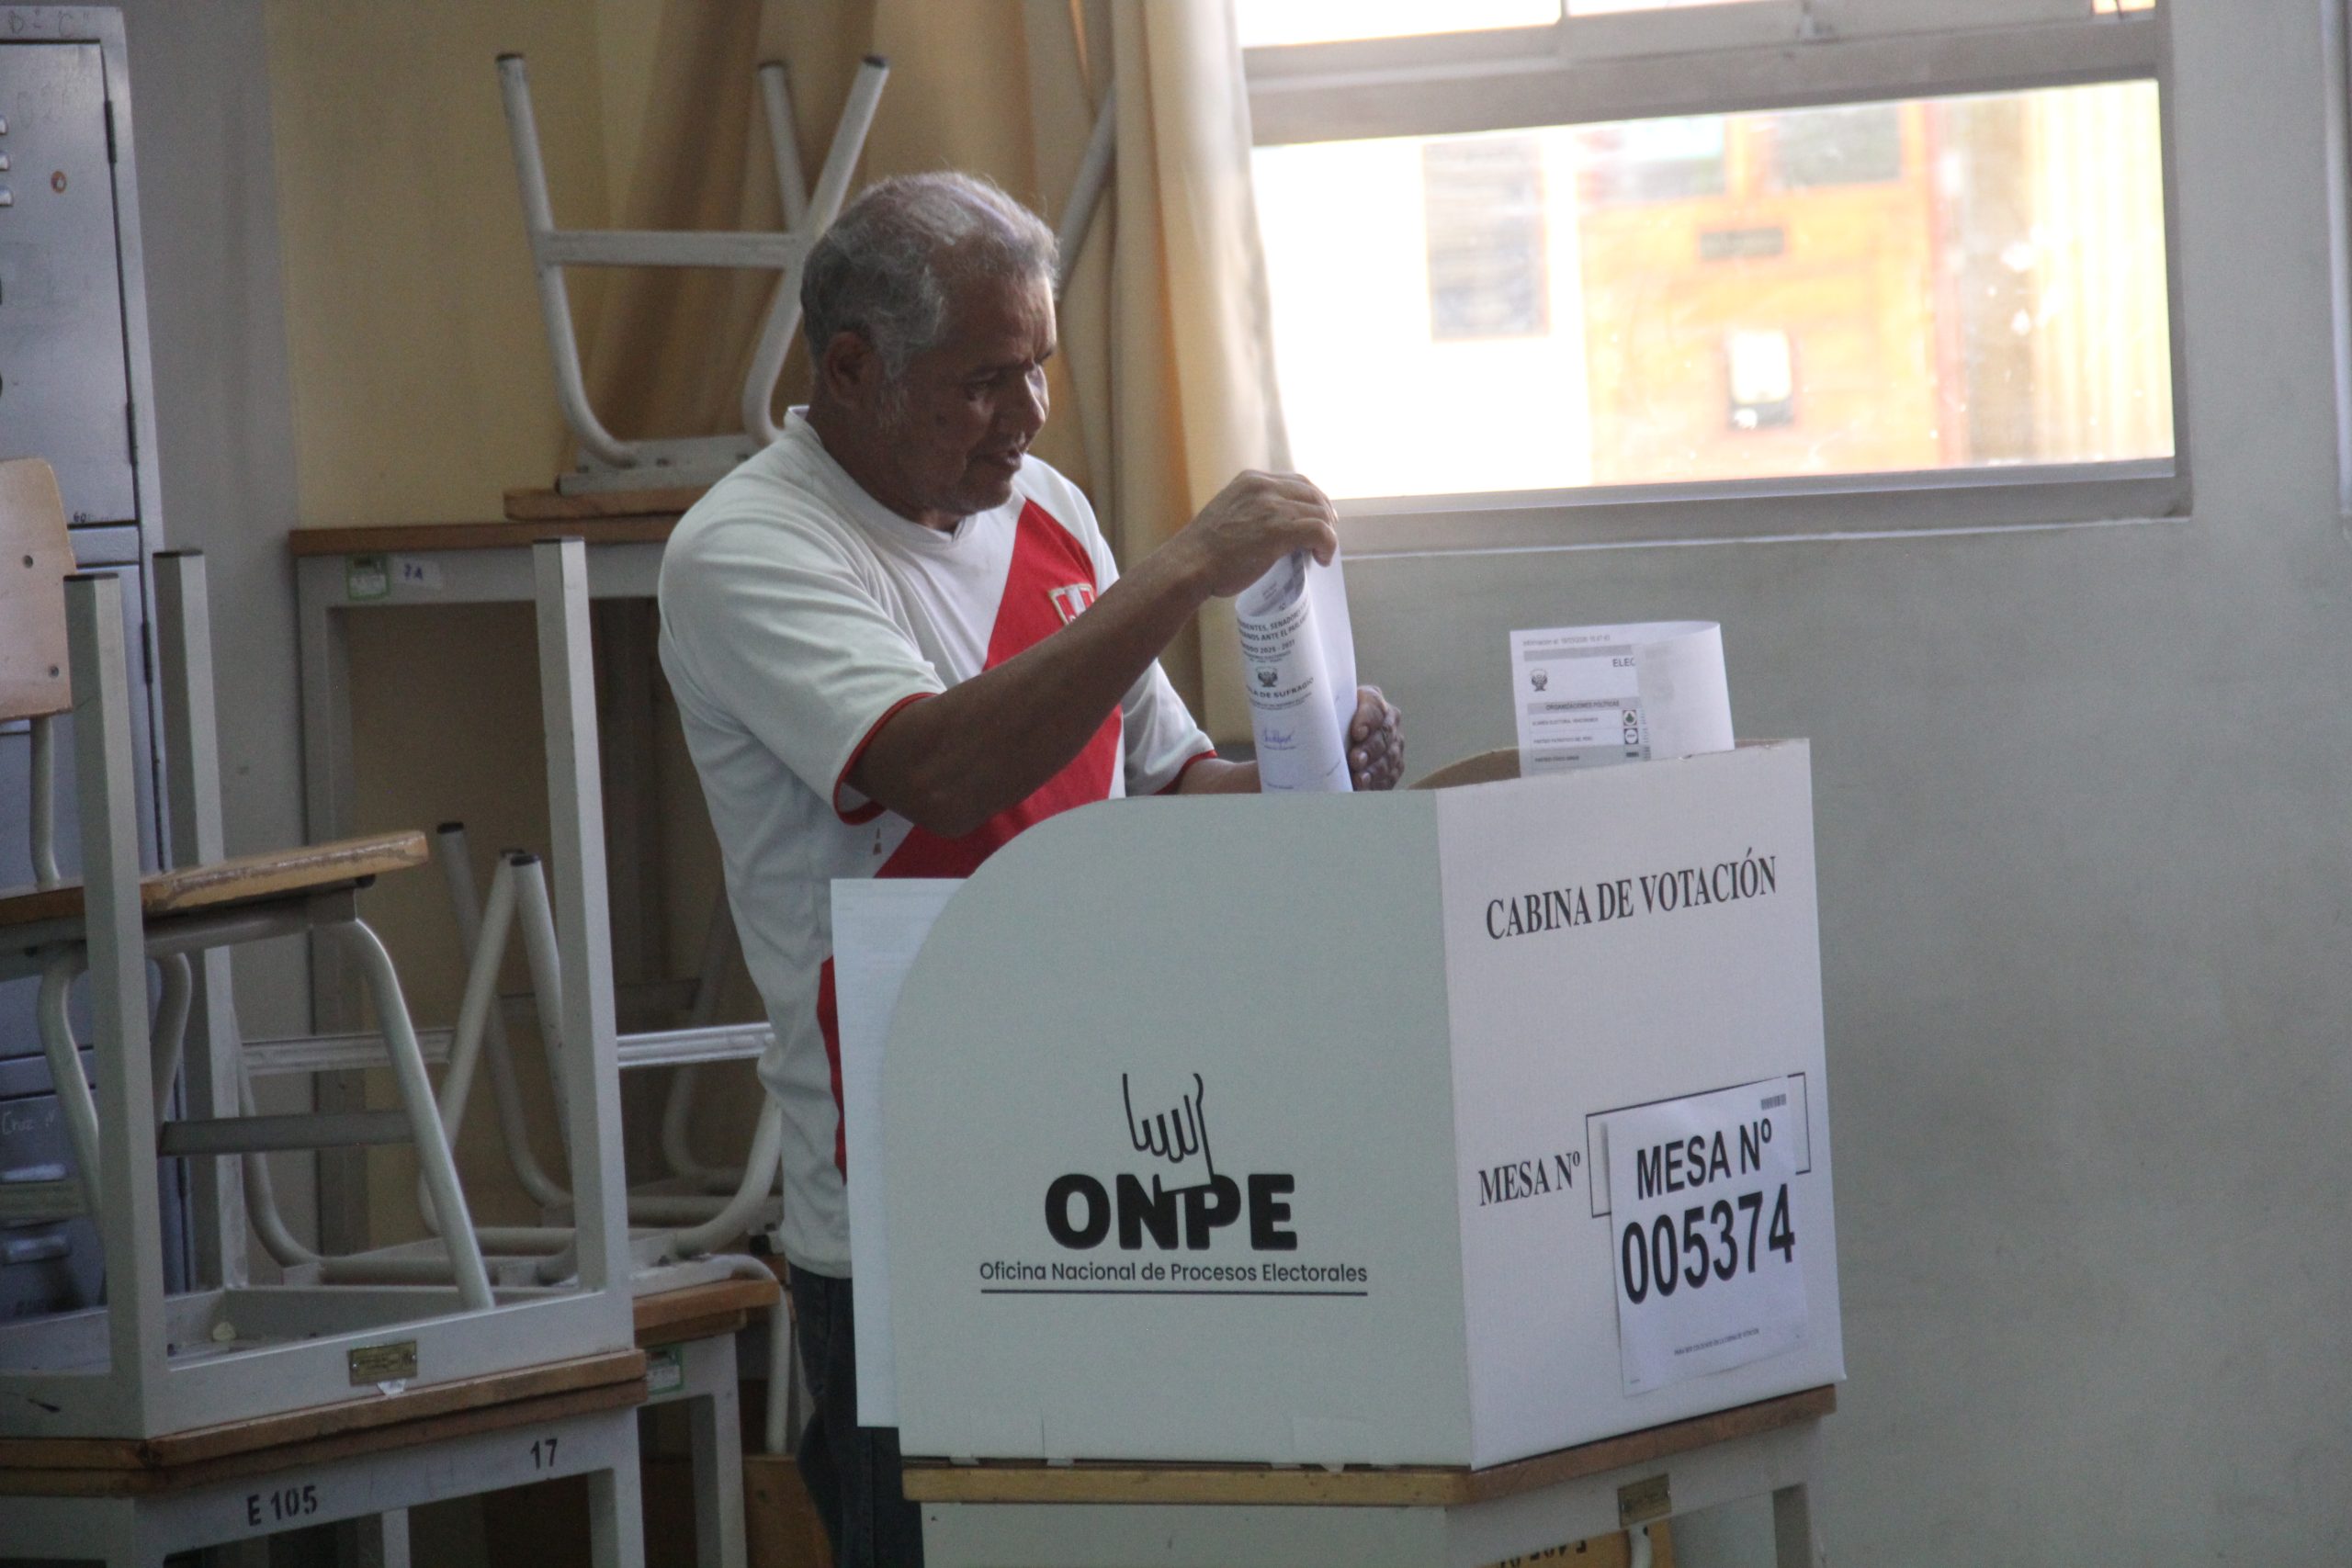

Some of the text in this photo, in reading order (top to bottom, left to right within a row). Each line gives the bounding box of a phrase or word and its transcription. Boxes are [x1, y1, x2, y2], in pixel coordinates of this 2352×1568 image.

[1486, 847, 1777, 940] CABINA DE VOTACIÓN
[1477, 1157, 1551, 1206] MESA
[1637, 1130, 1732, 1200] MESA
[1045, 1173, 1297, 1250] ONPE
[979, 1262, 1368, 1282] Oficina Nacional de Procesos Electorales
[1622, 1183, 1795, 1304] 005374
[530, 1438, 558, 1470] 17
[246, 1485, 317, 1527] E 105
